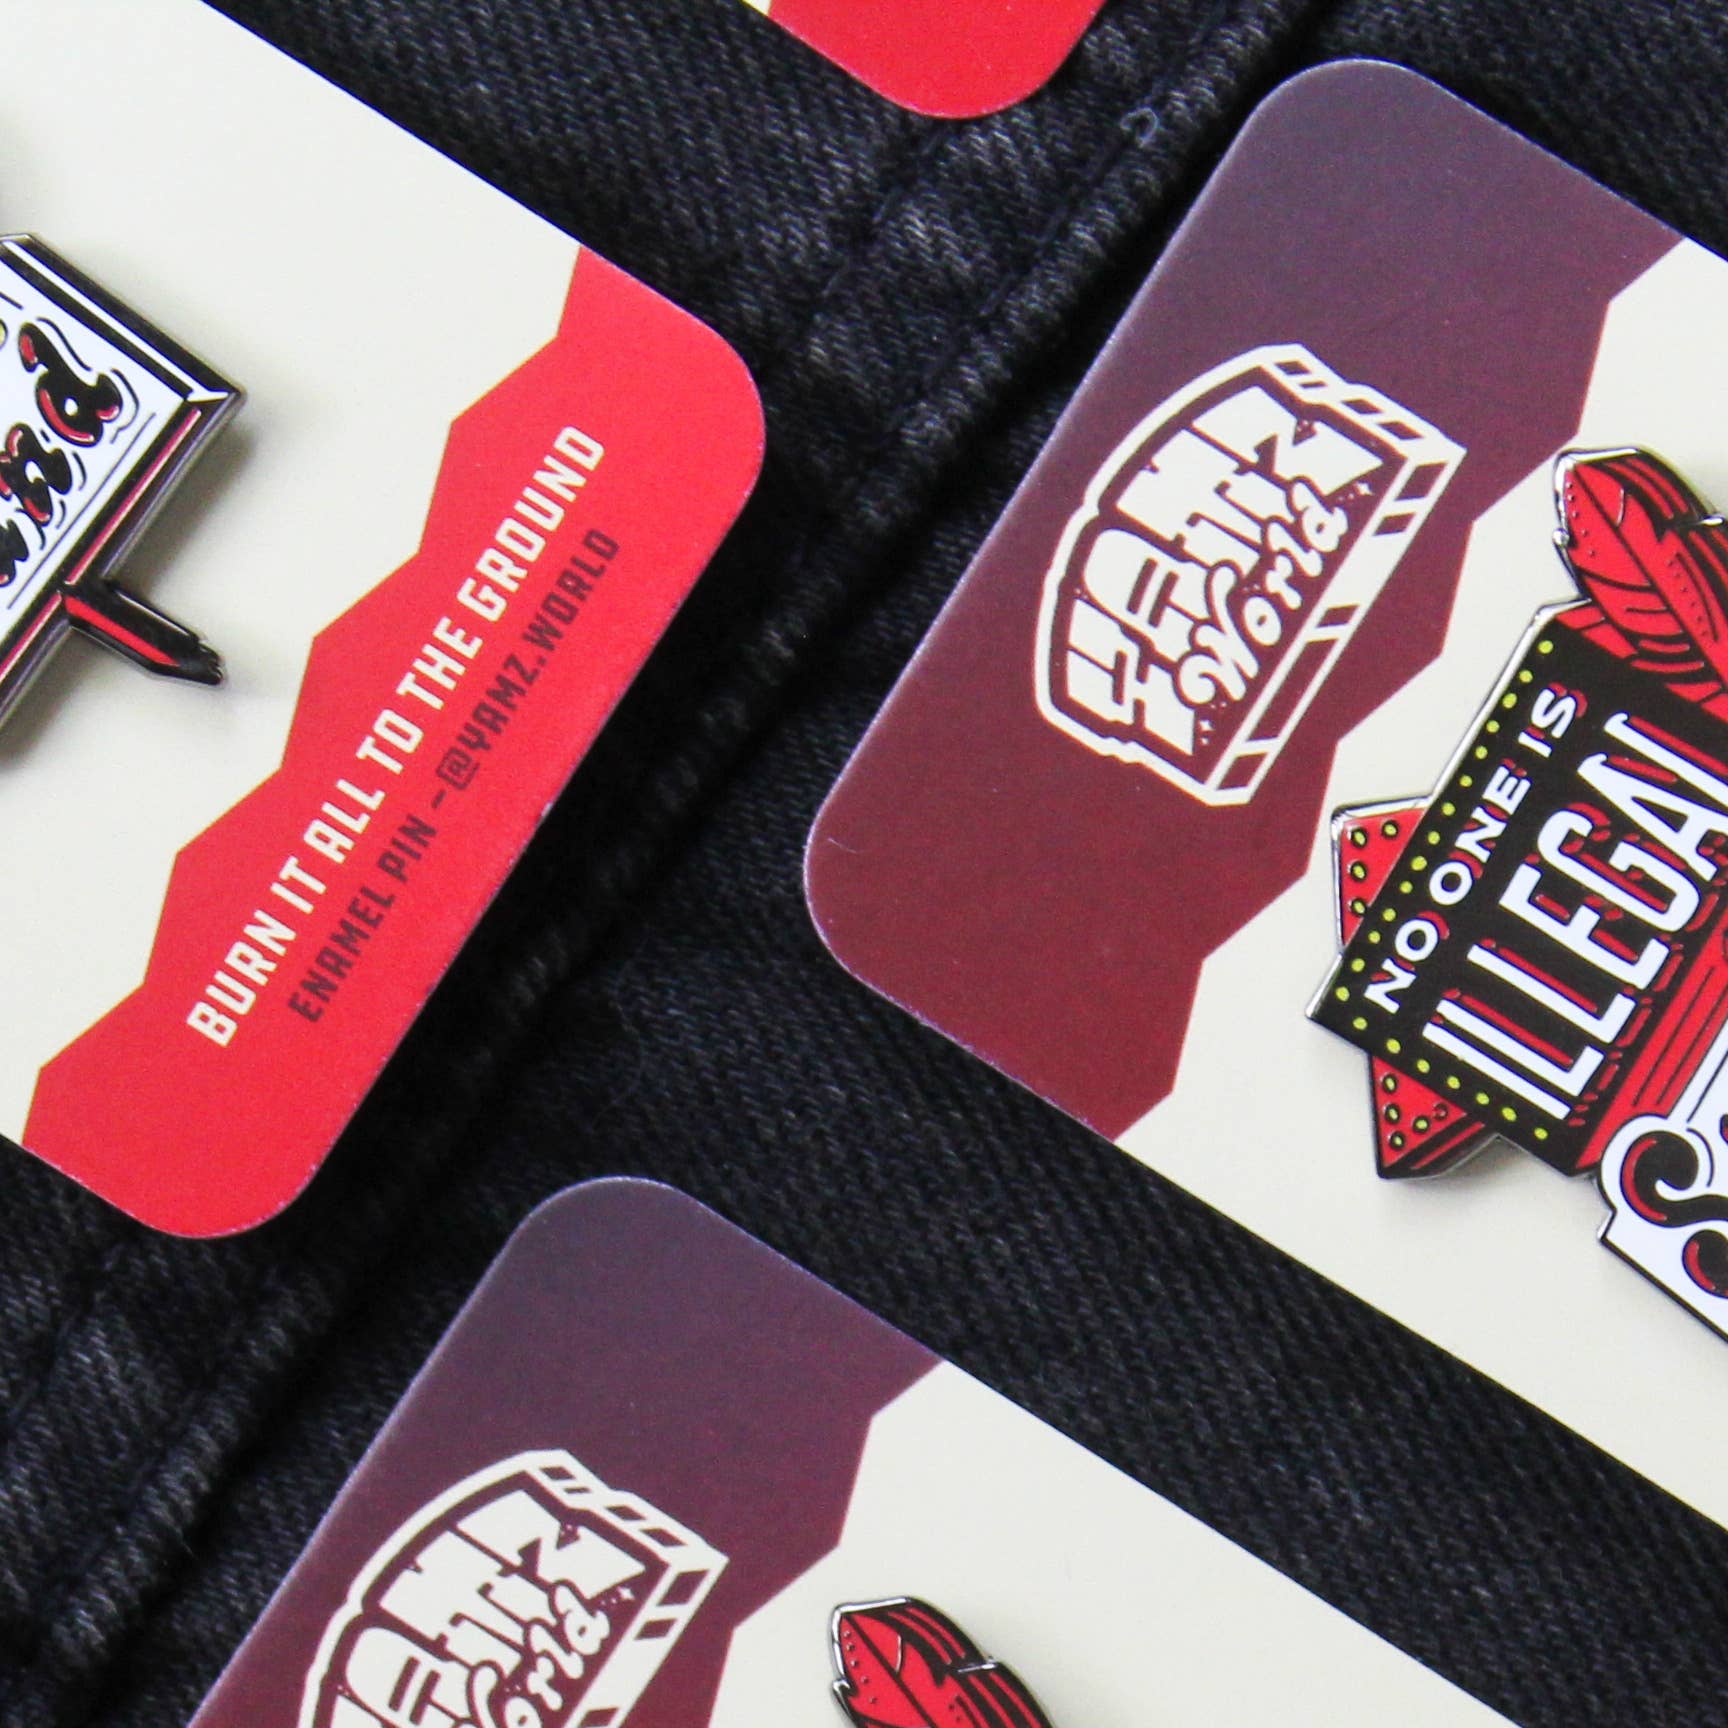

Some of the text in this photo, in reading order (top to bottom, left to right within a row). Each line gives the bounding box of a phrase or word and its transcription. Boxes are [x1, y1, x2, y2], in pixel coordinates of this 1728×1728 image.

[1179, 481, 1348, 703] World
[186, 428, 602, 1046] BURN IT ALL TO THE GROUND
[1364, 690, 1577, 1014] NO ONE IS
[288, 887, 395, 1021] ENAMEL
[377, 815, 436, 881] PIN
